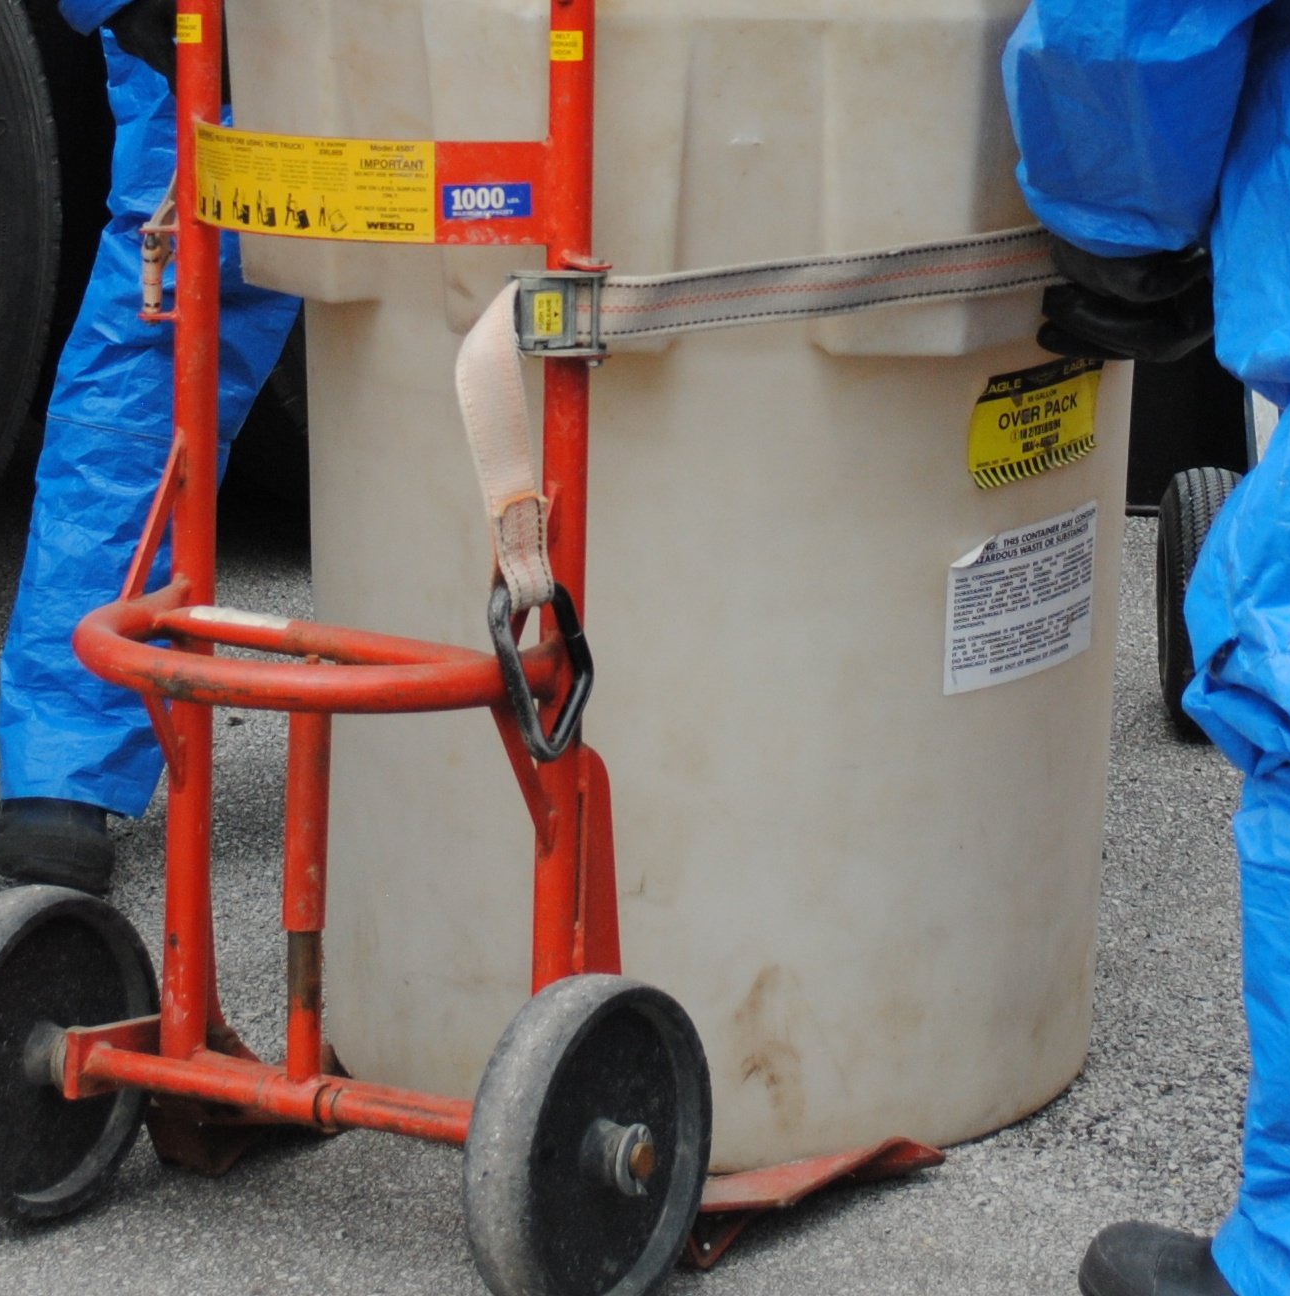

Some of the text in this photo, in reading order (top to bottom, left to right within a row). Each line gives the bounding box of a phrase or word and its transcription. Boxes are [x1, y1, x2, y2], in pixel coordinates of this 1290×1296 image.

[359, 159, 424, 171] IMPORTANT
[451, 187, 506, 210] 1000
[366, 221, 415, 231] WESCO
[986, 378, 1022, 394] AGLE
[998, 405, 1041, 431] OVER
[1045, 392, 1078, 418] PACK
[1003, 536, 1019, 547] THIS
[1021, 523, 1060, 543] CONTAINER
[1020, 540, 1043, 555] WASTE
